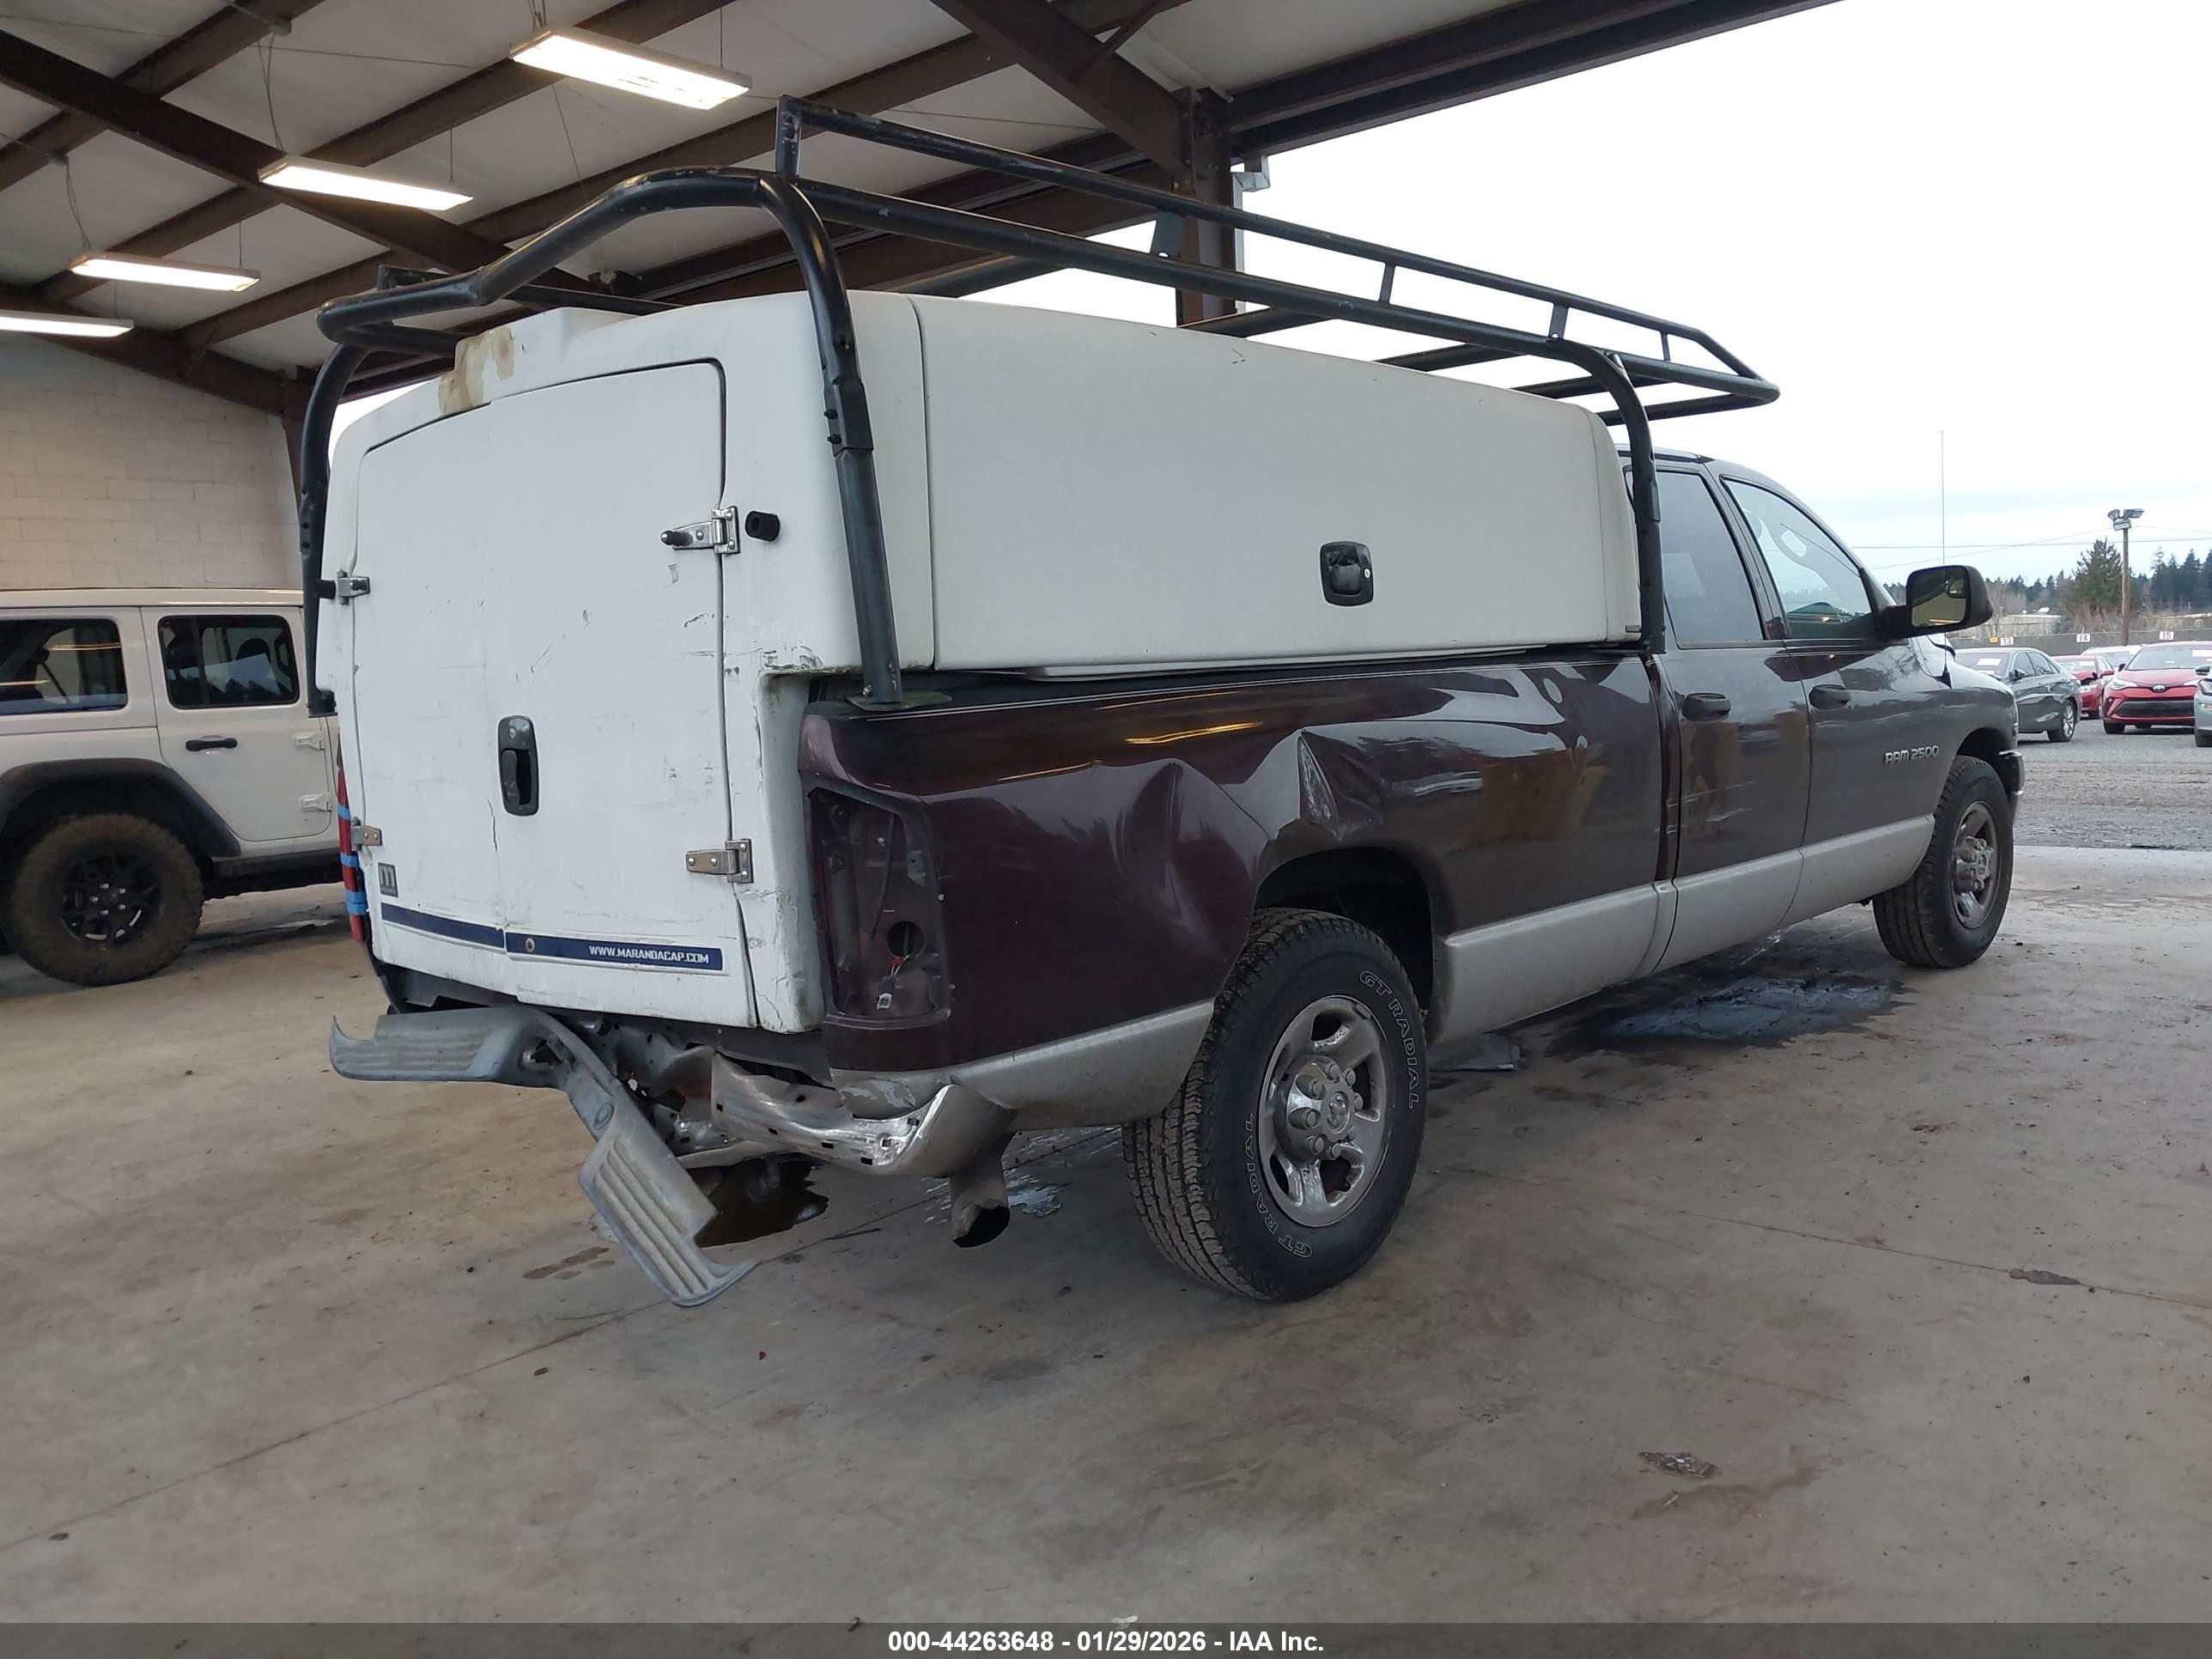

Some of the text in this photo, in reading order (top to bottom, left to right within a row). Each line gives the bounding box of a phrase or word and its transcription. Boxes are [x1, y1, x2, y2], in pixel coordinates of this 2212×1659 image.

[1911, 745, 1939, 760] 2500
[589, 945, 709, 963] WWW.MARANDACAP.COM
[1358, 970, 1422, 1110] GT RADIAL
[1244, 1113, 1313, 1258] GT RADIAL
